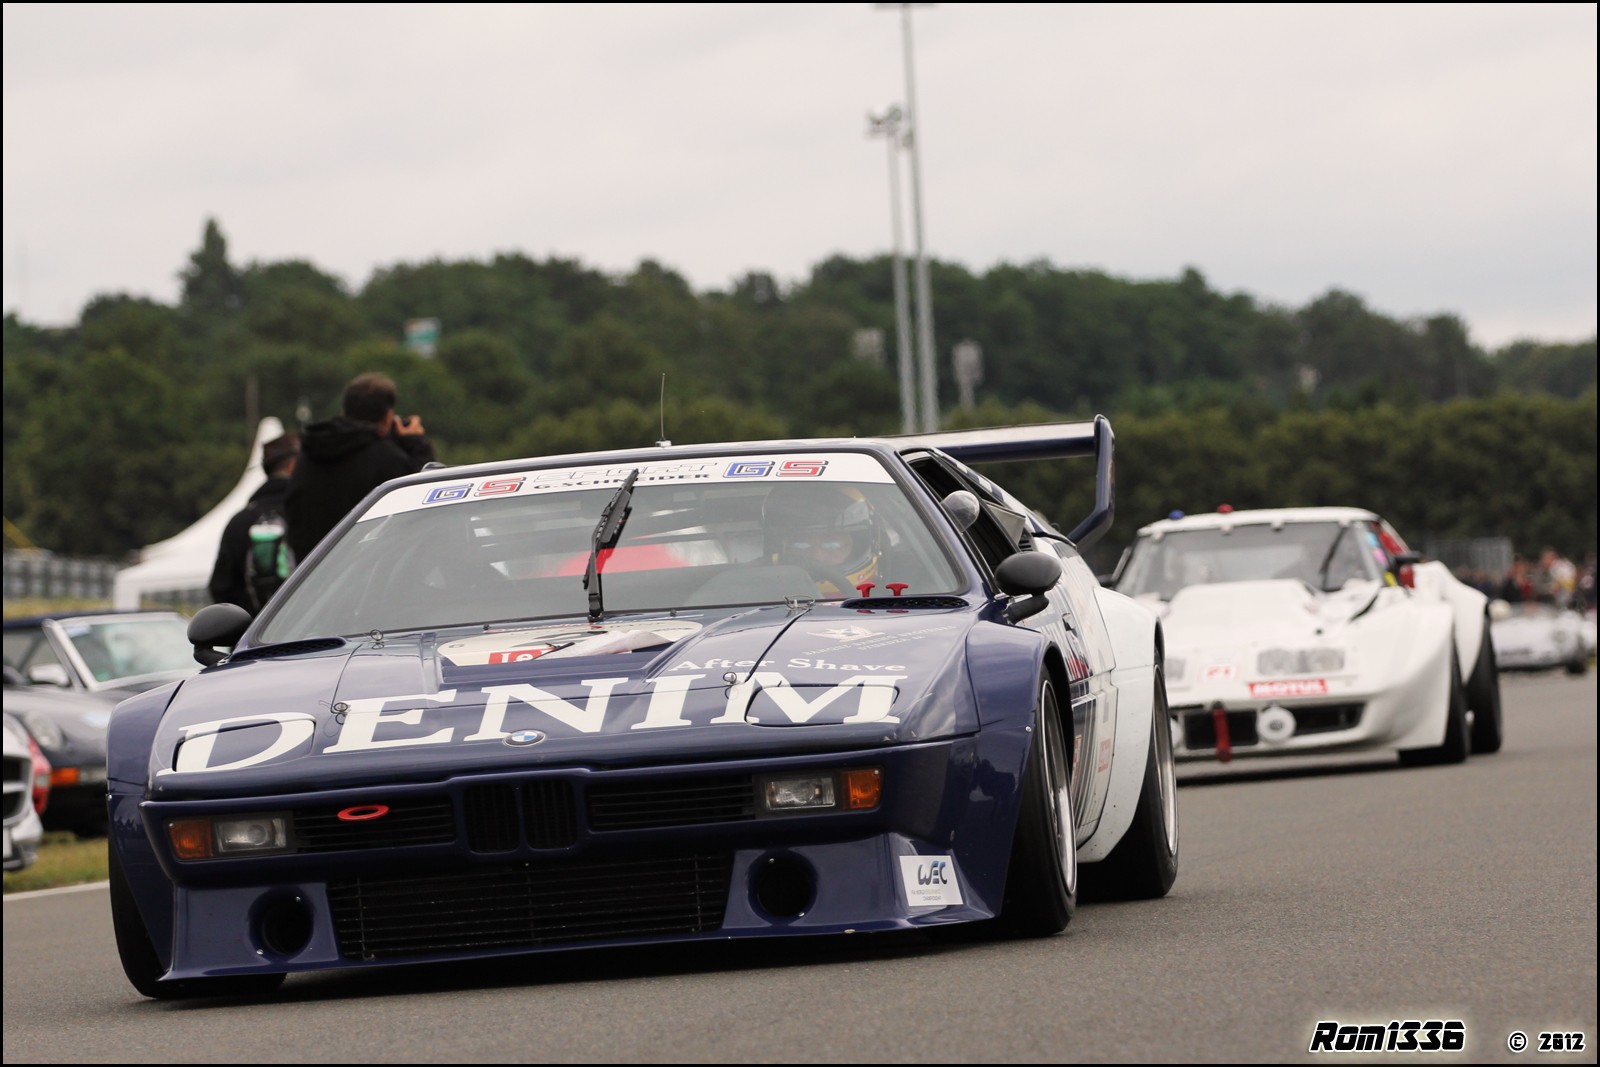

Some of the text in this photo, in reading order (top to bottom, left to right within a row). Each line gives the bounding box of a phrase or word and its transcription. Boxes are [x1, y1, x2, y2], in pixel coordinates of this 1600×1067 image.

[668, 657, 906, 671] After Shave
[1253, 680, 1323, 695] MOTUL
[156, 672, 908, 776] DENIM
[918, 860, 947, 885] WEC
